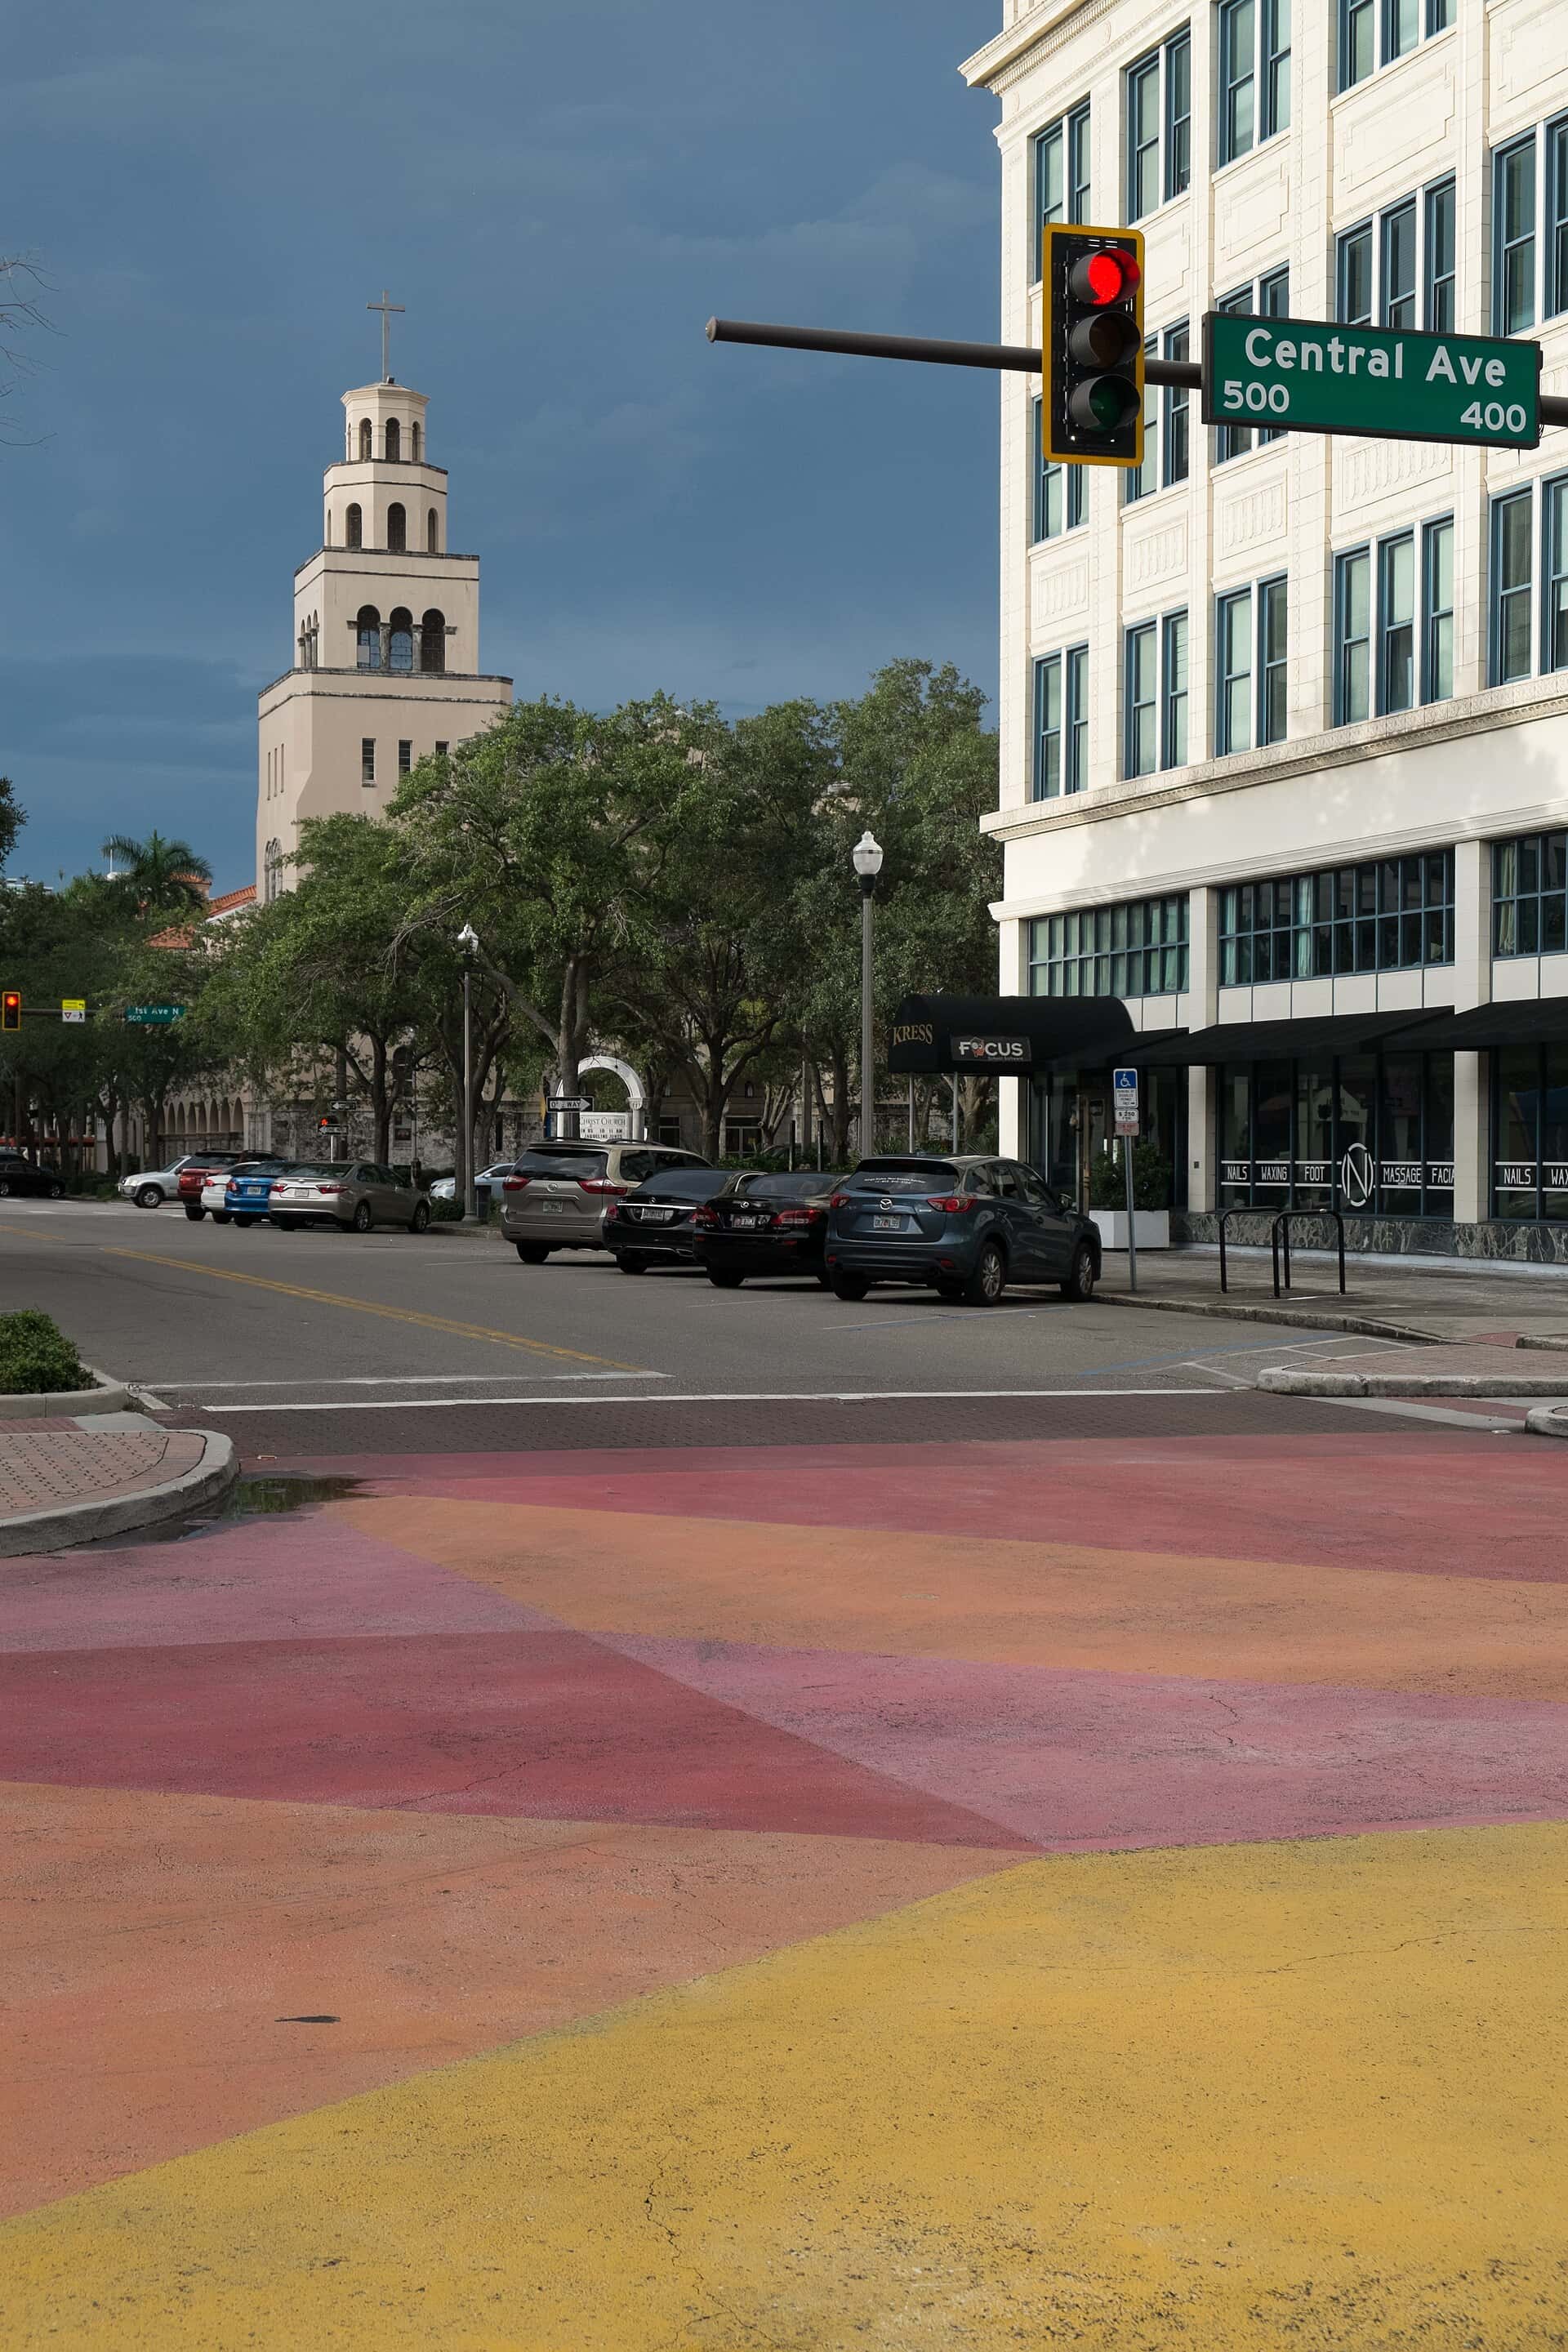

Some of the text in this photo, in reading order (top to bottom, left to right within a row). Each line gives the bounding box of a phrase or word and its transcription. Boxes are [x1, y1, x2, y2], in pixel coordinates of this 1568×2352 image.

[1245, 327, 1506, 388] Central Ave
[1223, 380, 1527, 434] 500 400
[151, 1007, 168, 1015] Ave
[172, 1007, 179, 1015] N
[893, 1023, 934, 1046] KRESS
[601, 1116, 626, 1125] CHURCH
[1227, 1166, 1248, 1180] NAILS
[1261, 1166, 1288, 1181] WAXING
[1304, 1166, 1325, 1182] FOOT
[1383, 1167, 1422, 1183] MASSAGE
[1503, 1168, 1531, 1184] NAILS
